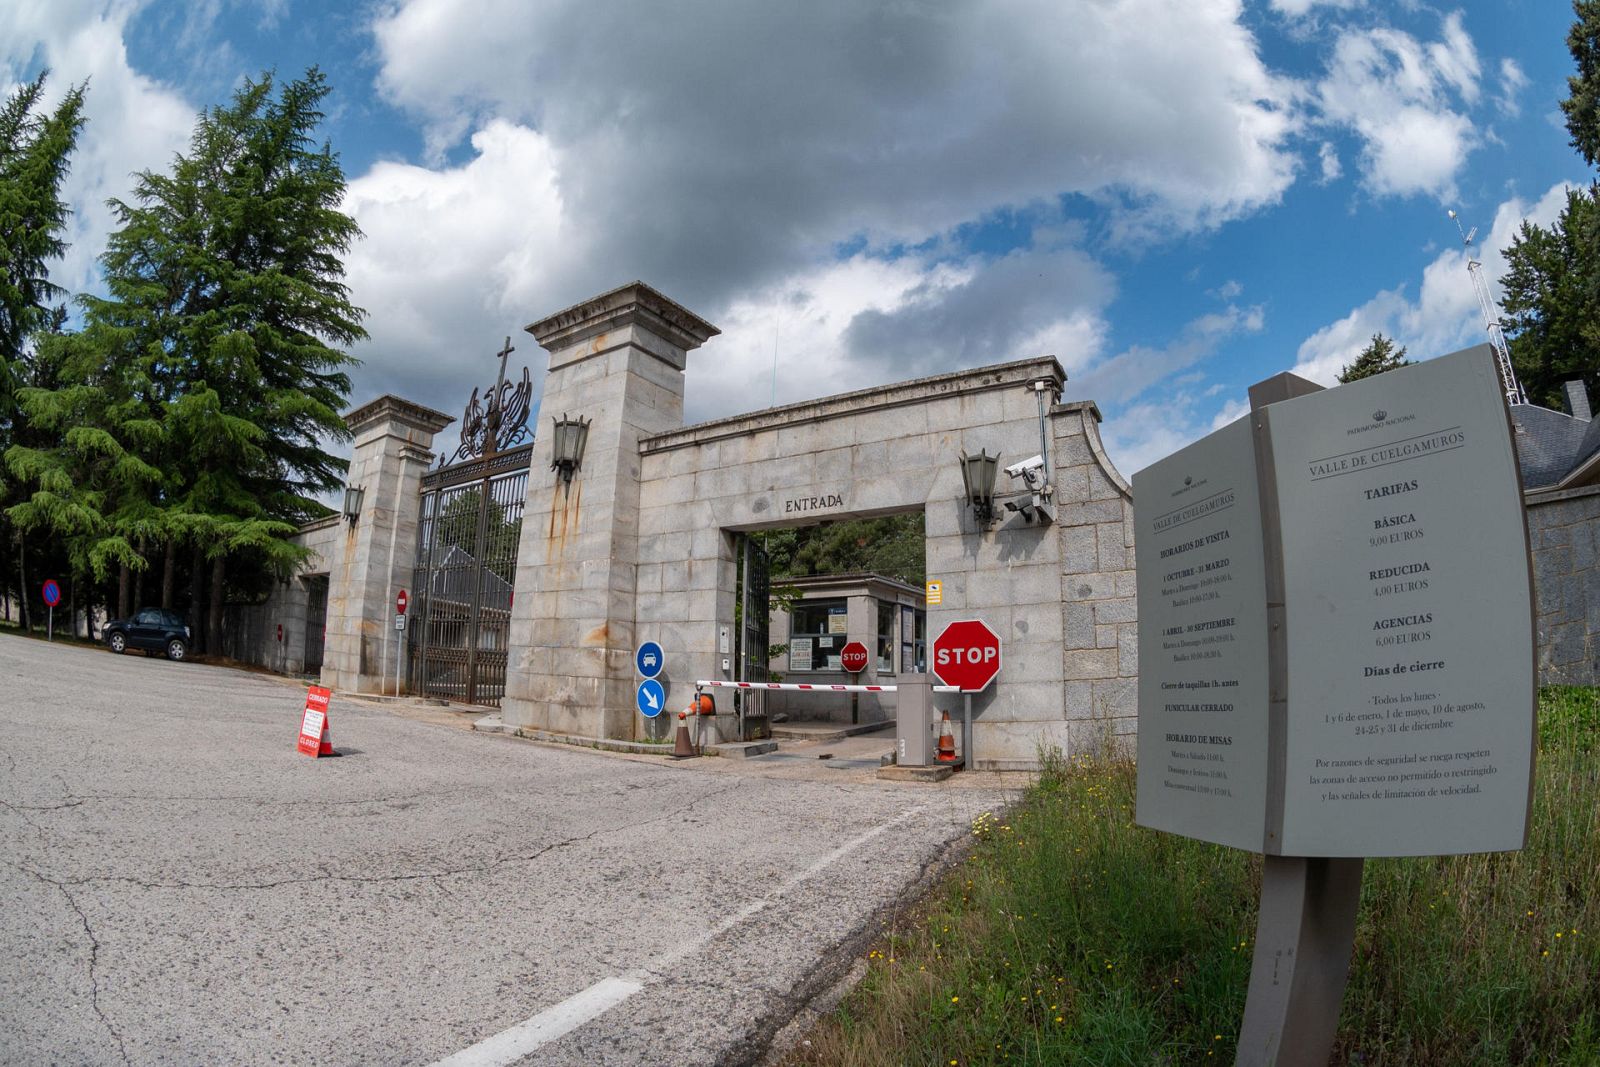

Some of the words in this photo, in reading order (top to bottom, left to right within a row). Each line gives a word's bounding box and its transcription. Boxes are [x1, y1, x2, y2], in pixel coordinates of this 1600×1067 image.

[1309, 460, 1348, 476] VALLE
[1351, 455, 1367, 467] DE
[1371, 432, 1464, 462] CUELGAMUROS
[1364, 480, 1418, 500] TARIFAS
[785, 495, 843, 512] ENTRADA
[1153, 517, 1172, 530] VALLE
[1374, 513, 1416, 529] BÁSICA
[1160, 541, 1193, 559] HORARIOS
[1195, 538, 1205, 548] DE
[1205, 530, 1230, 544] VISITA
[1389, 528, 1424, 544] EUROS
[1167, 567, 1195, 581] OCTUBRE
[1205, 558, 1230, 571] MARZO
[1369, 562, 1430, 580] REDUCIDA
[1394, 580, 1429, 594] EUROS
[1166, 626, 1184, 636] ABRIL
[1194, 617, 1236, 632] SEPTIEMBRE
[1373, 613, 1432, 630] AGENCIAS
[1396, 631, 1431, 645] EUROS
[843, 652, 866, 661] STOP
[937, 646, 997, 665] STOP
[1364, 666, 1390, 677] Días
[1393, 664, 1407, 674] de
[1410, 661, 1445, 672] cierre
[1161, 682, 1177, 690] Cierre
[1178, 681, 1184, 689] de
[1185, 680, 1210, 691] taquillas
[1400, 693, 1412, 703] los
[1414, 692, 1437, 702] lunes
[1165, 704, 1200, 712] FUNICULAR
[1200, 704, 1234, 712] CERRADO
[1331, 715, 1336, 724] y
[1345, 712, 1356, 722] de
[1357, 713, 1383, 721] enero,
[1392, 708, 1403, 718] de
[1405, 708, 1430, 718] mayo,
[1433, 704, 1443, 714] 10
[1444, 703, 1455, 713] de
[1456, 702, 1485, 714] agosto,
[1355, 724, 1379, 735] 24-25
[1380, 726, 1385, 736] y
[1387, 723, 1396, 733] 31
[1399, 722, 1410, 732] de
[1411, 719, 1454, 731] diciembre
[1166, 733, 1197, 744] HORARIO
[1198, 735, 1208, 744] DE
[1209, 736, 1232, 745] MISAS
[1315, 758, 1329, 767] Por
[1331, 759, 1363, 767] razones
[1364, 756, 1375, 766] de
[1377, 753, 1417, 767] seguridad
[1430, 753, 1453, 763] ruega
[1455, 750, 1490, 760] respeten
[1309, 776, 1320, 784] las
[1346, 774, 1357, 783] de
[1359, 775, 1386, 783] acceso
[1400, 769, 1442, 783] permitido
[1451, 764, 1497, 777] restringido
[1321, 793, 1327, 802] y
[1328, 791, 1339, 800] las
[1341, 790, 1370, 800] señales
[1372, 789, 1382, 799] de
[1427, 787, 1438, 796] de
[1440, 784, 1482, 796] velocidad.
